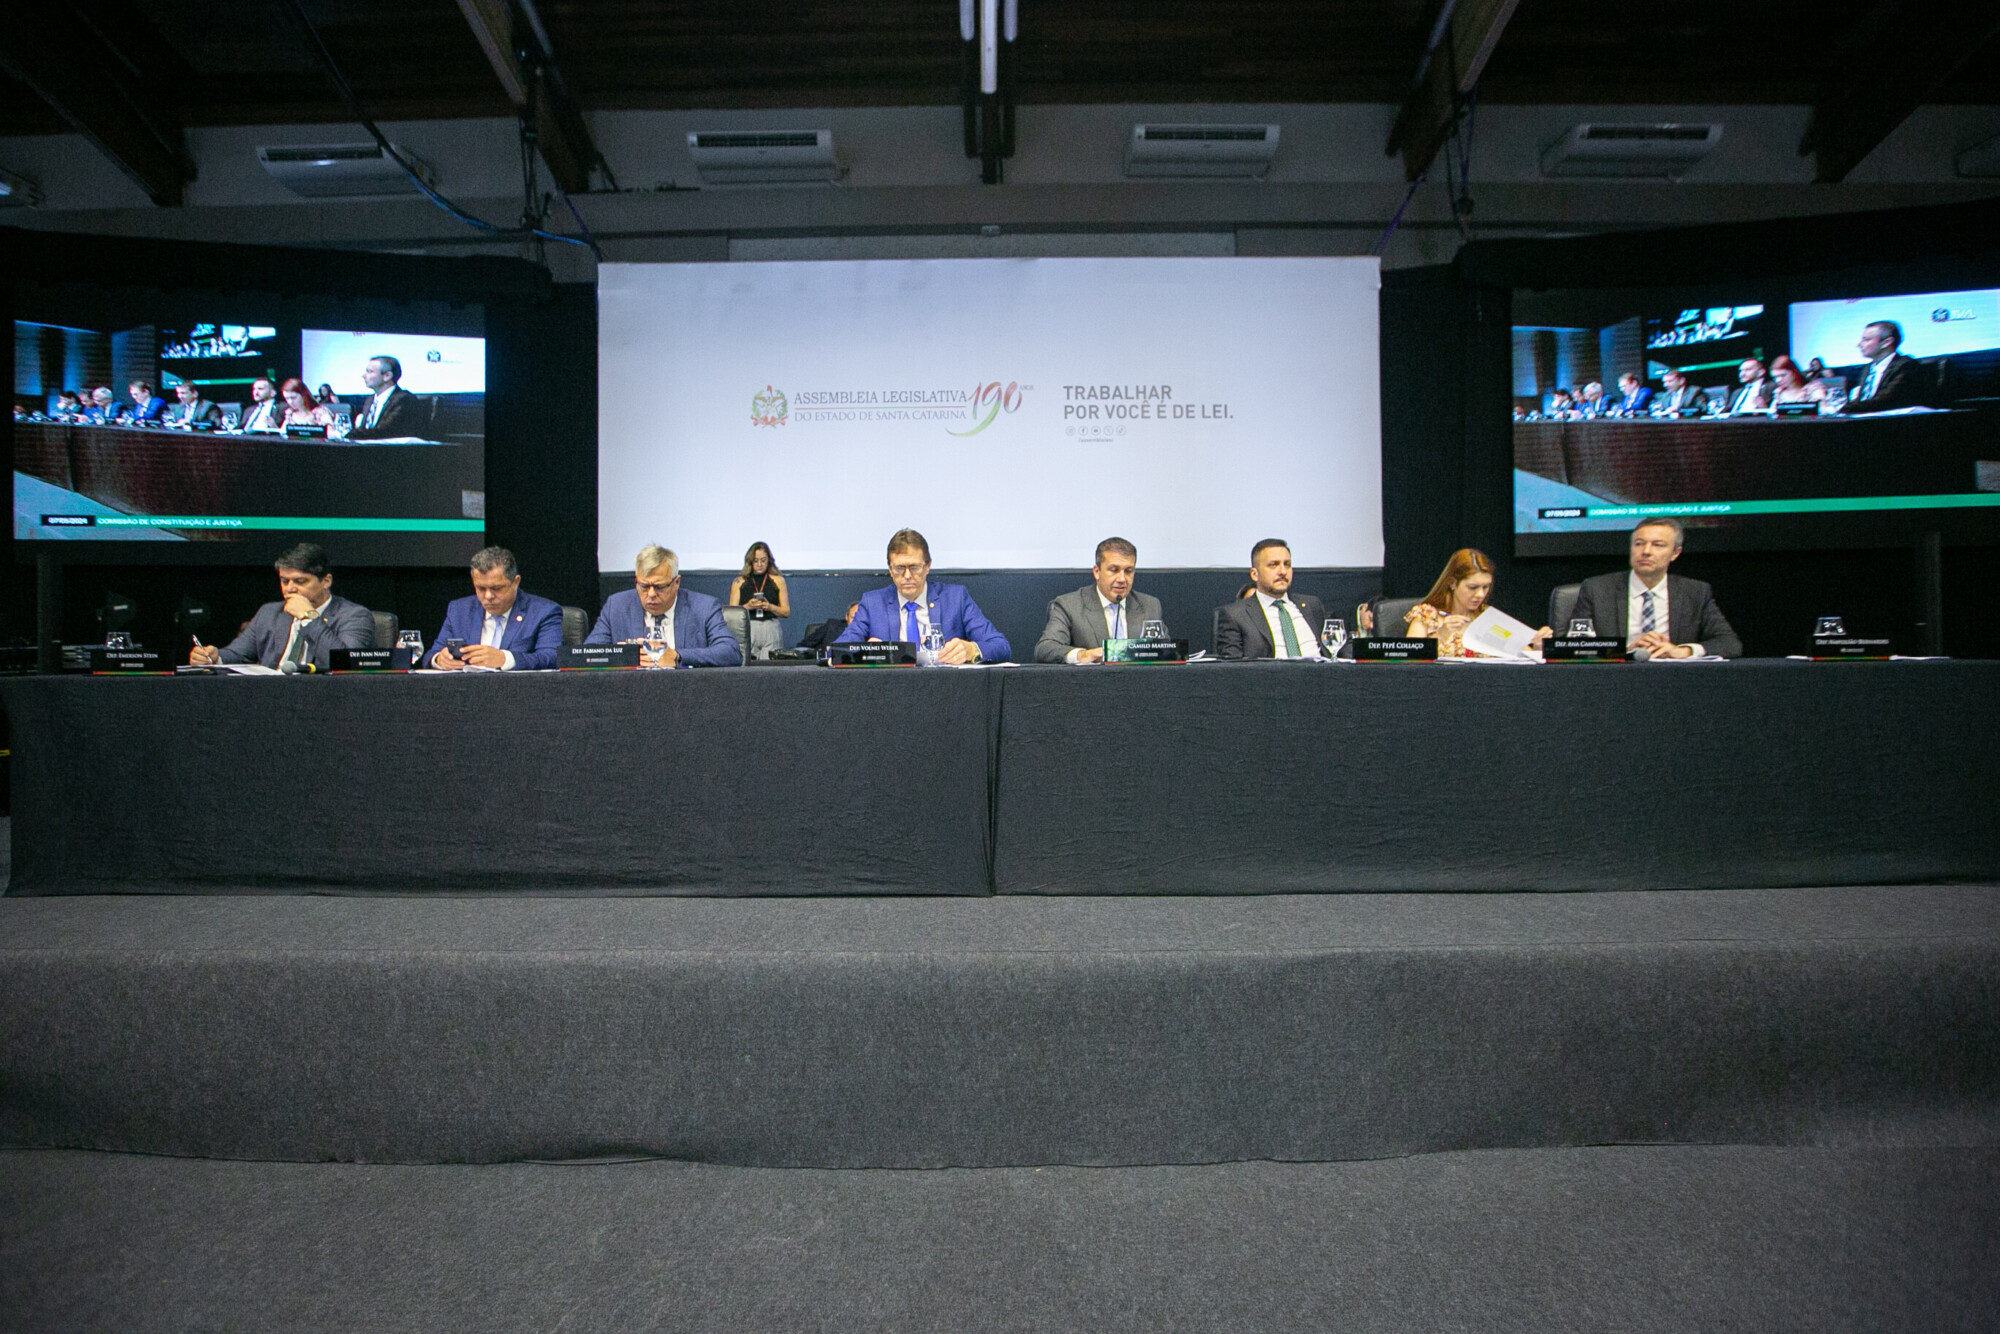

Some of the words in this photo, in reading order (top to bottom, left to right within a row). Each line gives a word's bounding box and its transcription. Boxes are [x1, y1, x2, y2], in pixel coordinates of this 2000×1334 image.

[794, 391, 878, 405] ASSEMBLEIA
[882, 390, 967, 403] LEGISLATIVA
[1063, 385, 1172, 400] TRABALHAR
[795, 412, 812, 421] DO
[815, 411, 856, 421] ESTADO
[859, 411, 873, 420] DE
[876, 411, 910, 420] SANTA
[912, 410, 967, 420] CATARINA
[1064, 405, 1100, 419] POR
[1105, 399, 1150, 419] VOCÊ
[1157, 398, 1167, 419] É
[1173, 404, 1196, 419] DE
[1201, 404, 1234, 419] LEI.
[97, 516, 138, 525] COMISSÃO
[151, 518, 205, 527] CONSTITUIÇÃO
[212, 519, 243, 527] JUSTIÇA
